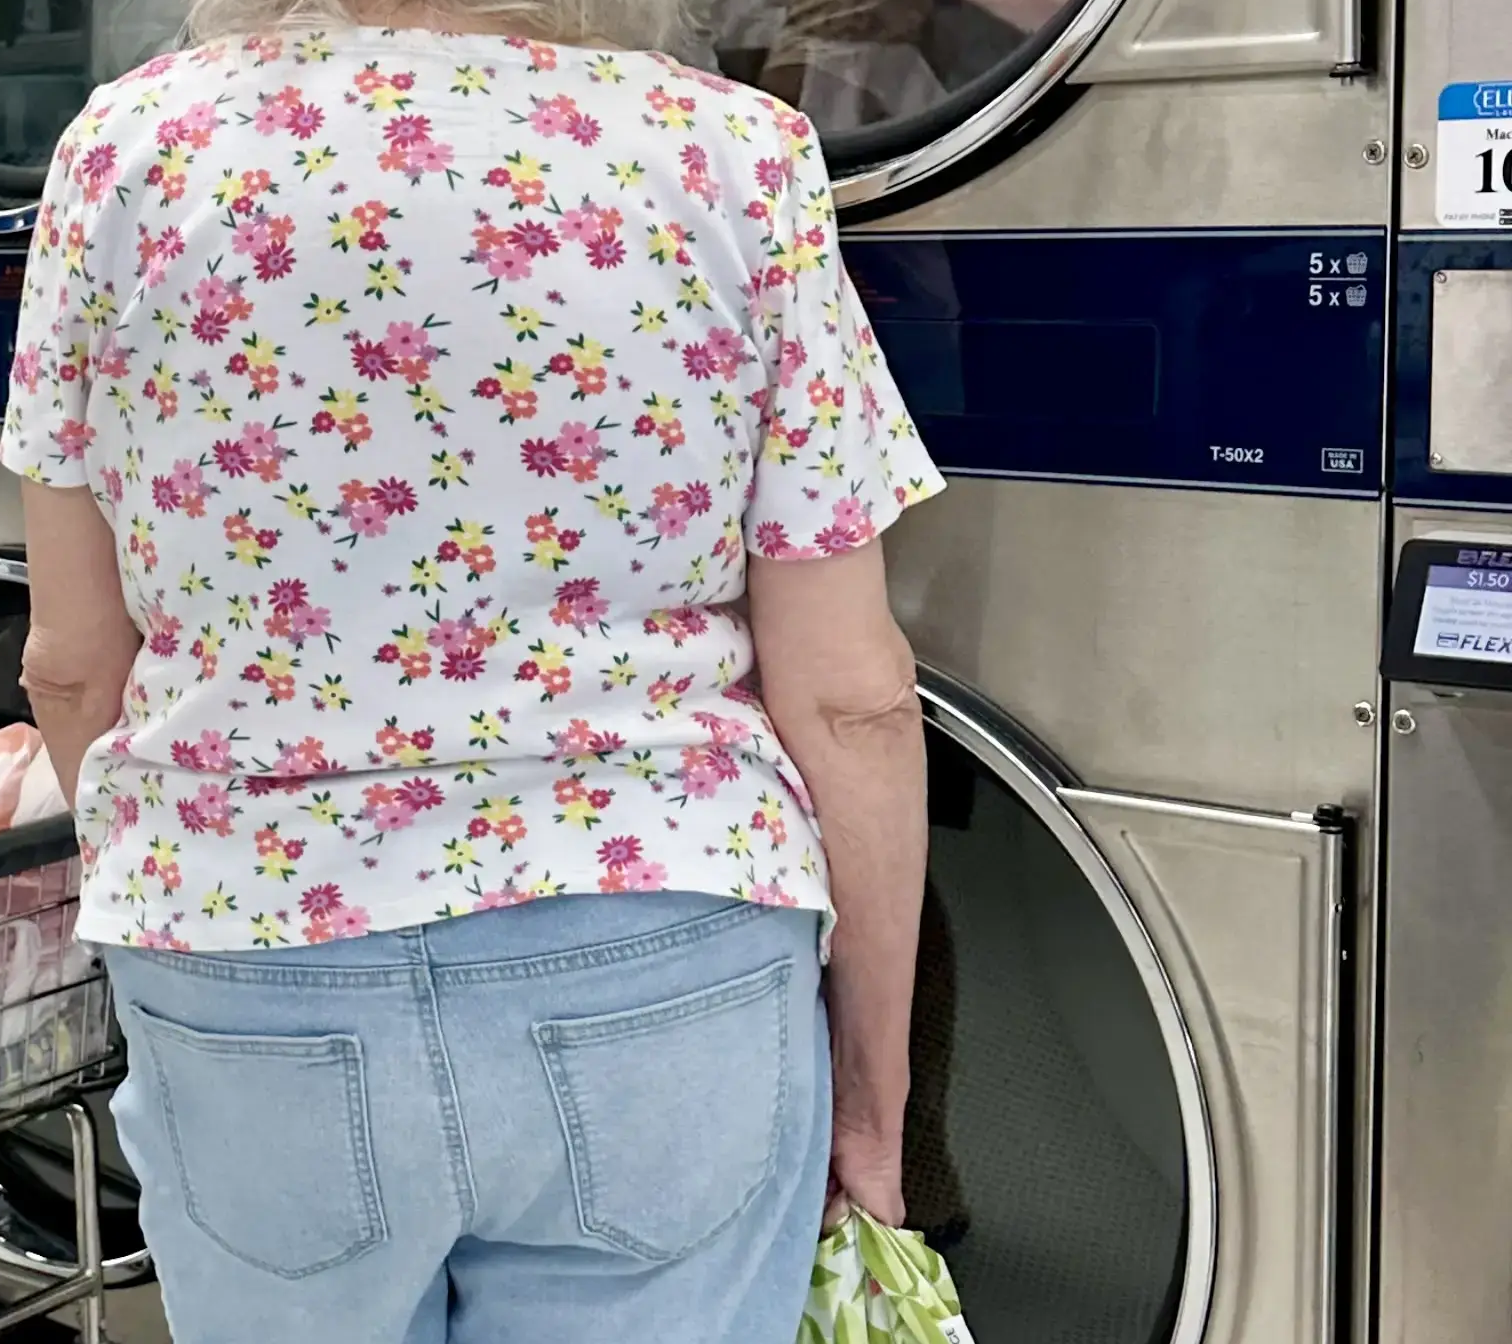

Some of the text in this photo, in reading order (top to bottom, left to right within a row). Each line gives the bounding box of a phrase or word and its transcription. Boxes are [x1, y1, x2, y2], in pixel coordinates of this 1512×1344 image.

[1308, 252, 1341, 275] 5 x
[1308, 284, 1341, 307] 5 x
[1210, 446, 1264, 464] T-50X2
[1330, 458, 1355, 470] USA
[1467, 570, 1509, 588] $1.50
